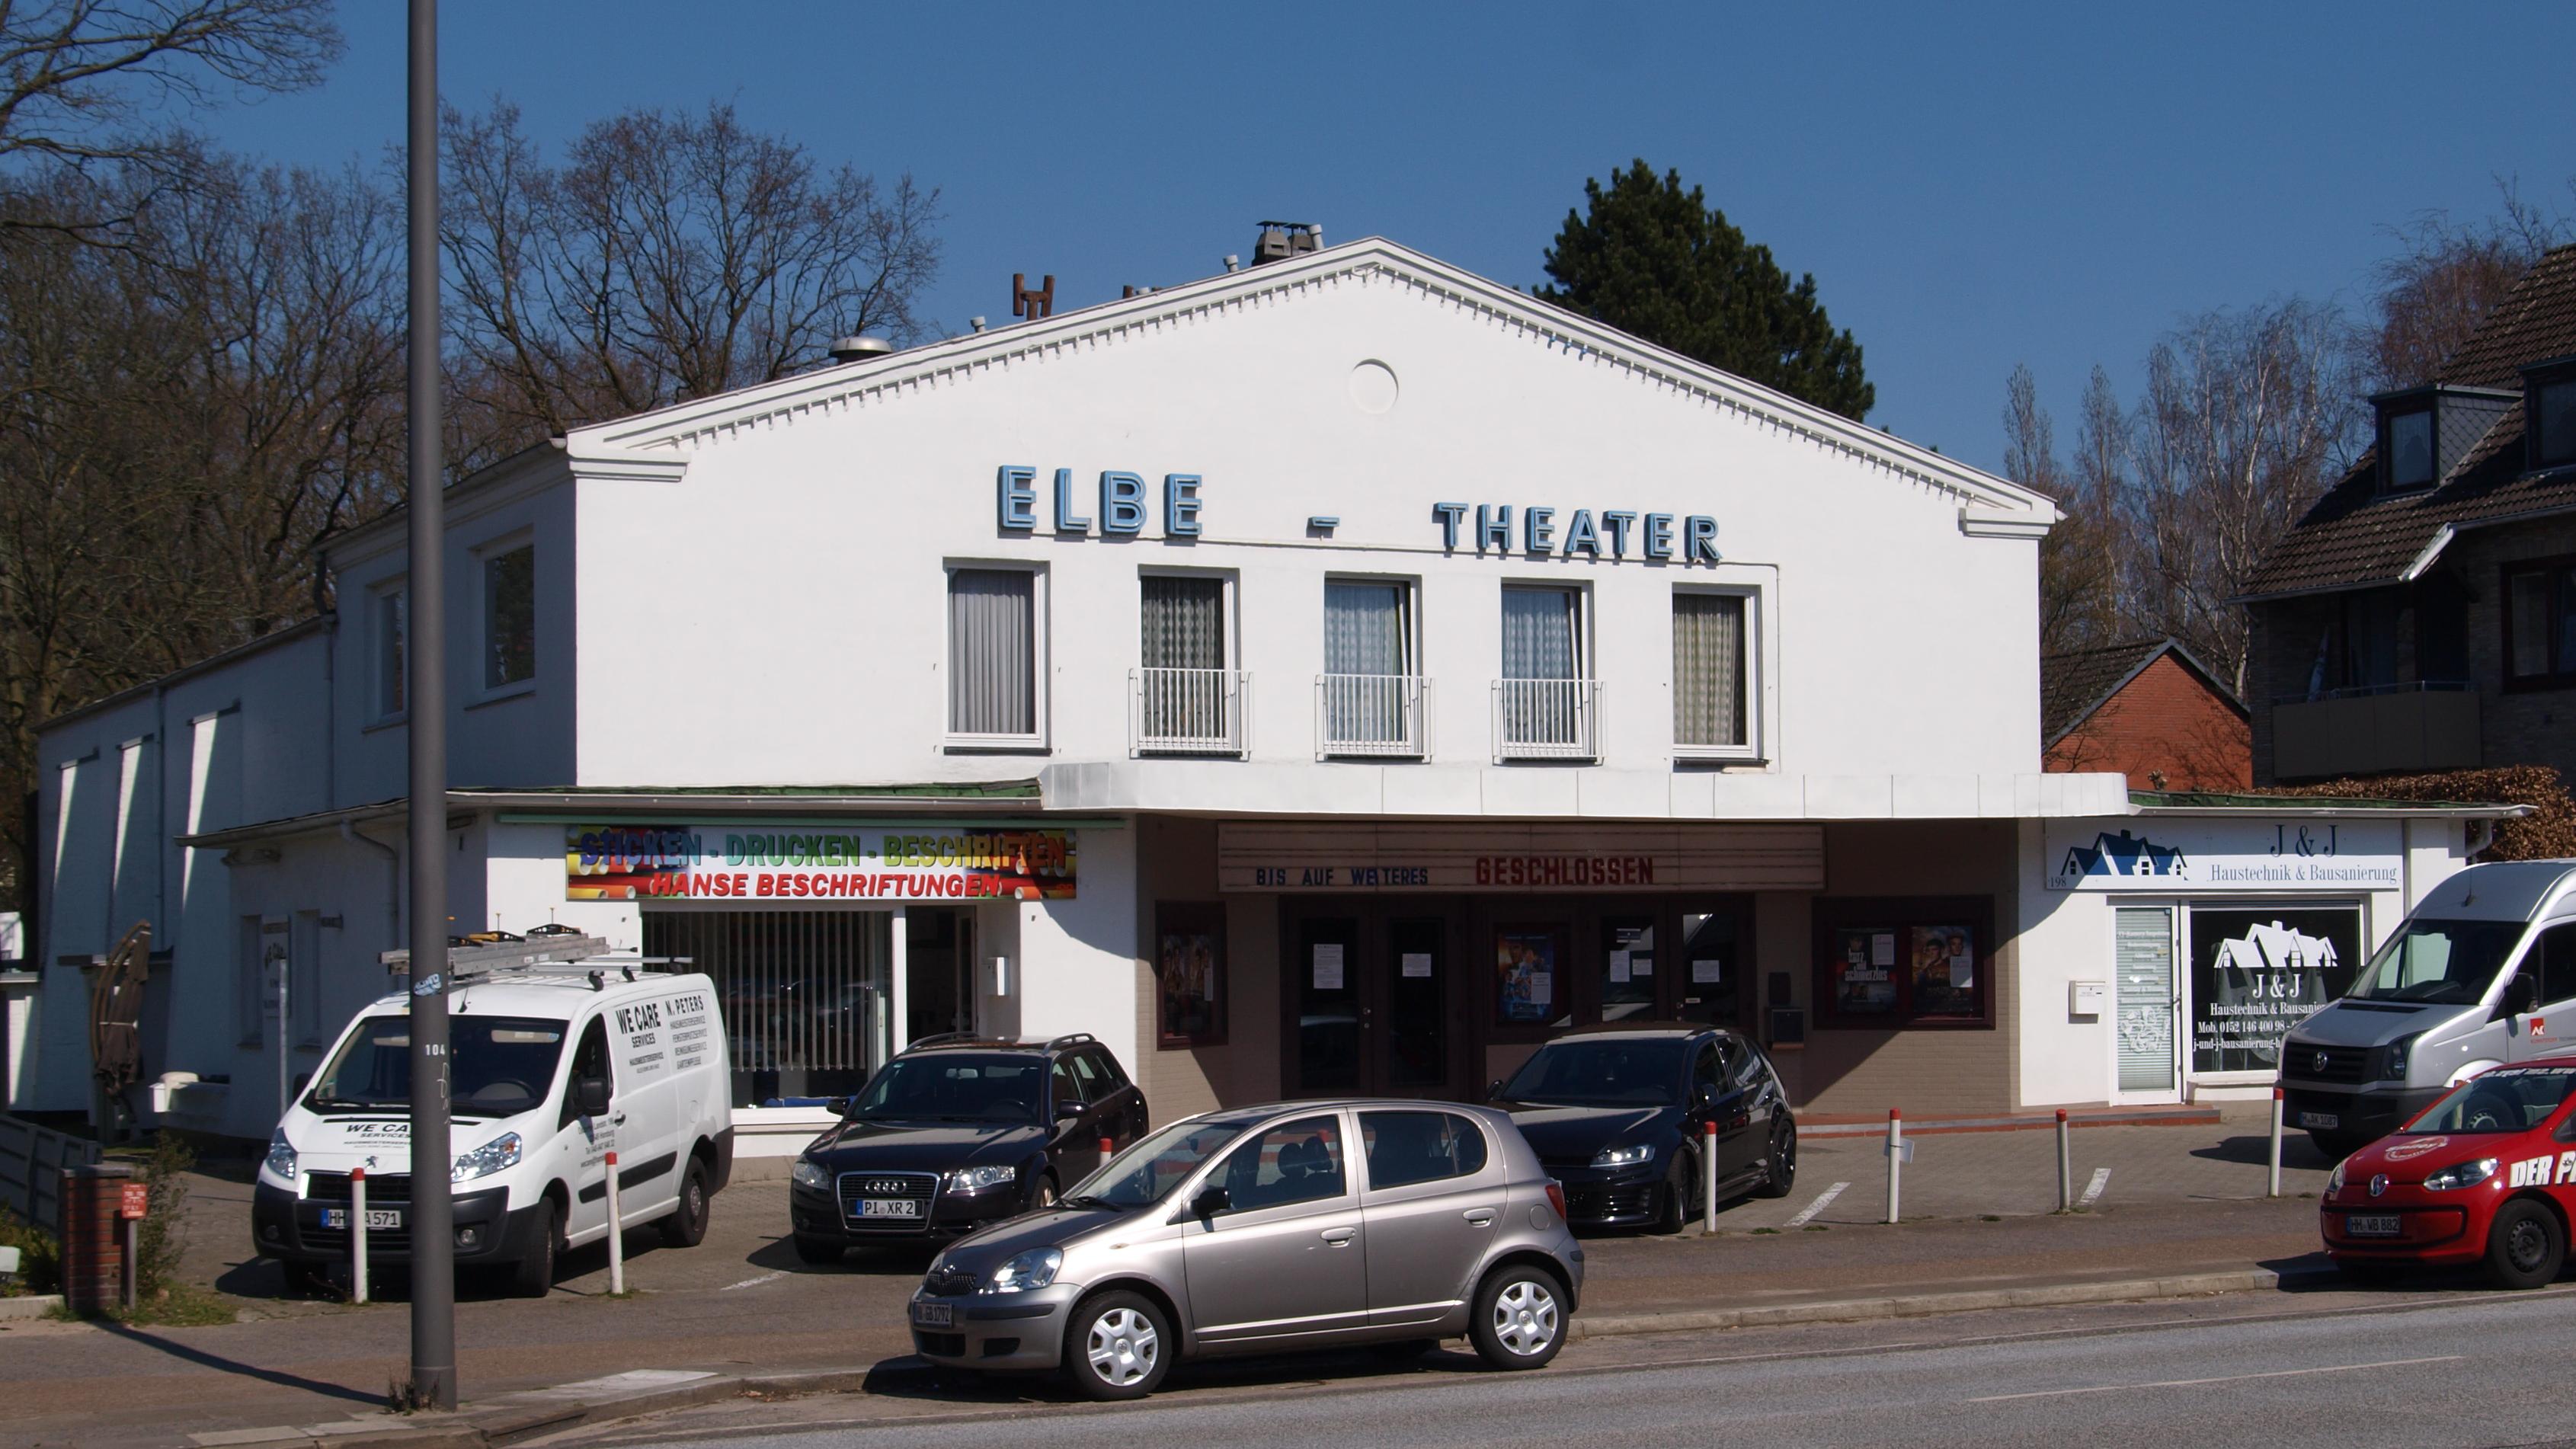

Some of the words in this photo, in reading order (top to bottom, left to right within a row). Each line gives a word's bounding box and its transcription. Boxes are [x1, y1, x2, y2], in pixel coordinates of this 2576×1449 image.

[997, 465, 1202, 536] ELBE
[1434, 501, 1723, 562] THEATER
[580, 831, 702, 866] STICKEN
[726, 834, 861, 867] DRUCKEN
[883, 833, 1066, 868] BESCHRIFTEN
[2270, 824, 2286, 857] J
[2296, 825, 2315, 857] &
[2324, 824, 2339, 857] J
[1256, 868, 1285, 885] BIS
[1302, 868, 1334, 886] AUF
[1476, 858, 1653, 886] GESCHLOSSEN
[2211, 864, 2291, 881] Haustechnik
[2295, 865, 2308, 881] &
[2310, 863, 2397, 884] Bausanierung
[652, 872, 747, 897] HANSE
[756, 872, 1000, 897] BESCHRIFTUNGEN
[2050, 878, 2067, 888] 198
[2252, 974, 2264, 999] J
[2270, 974, 2286, 998] &
[2290, 974, 2301, 998] J
[675, 995, 704, 1014] PETERS
[2210, 1002, 2267, 1016] Haustechnik
[2270, 1004, 2278, 1014] &
[616, 1008, 635, 1035] WE
[634, 1003, 661, 1031] CARE
[2198, 1021, 2218, 1033] Mob.
[2220, 1021, 2239, 1033] 0152
[2242, 1021, 2257, 1032] 146
[2258, 1020, 2274, 1032] 400
[2275, 1019, 2286, 1032] 98
[632, 1032, 656, 1048] SERVICES
[425, 1044, 446, 1056] 104
[347, 1124, 378, 1132] WE
[382, 1124, 410, 1132] CA
[2509, 1155, 2553, 1188] DER
[865, 1202, 878, 1214] PI
[887, 1202, 903, 1215] XR
[906, 1202, 914, 1215] 2
[374, 1212, 398, 1225] 571
[2366, 1218, 2379, 1231] WB
[2381, 1218, 2398, 1231] 882
